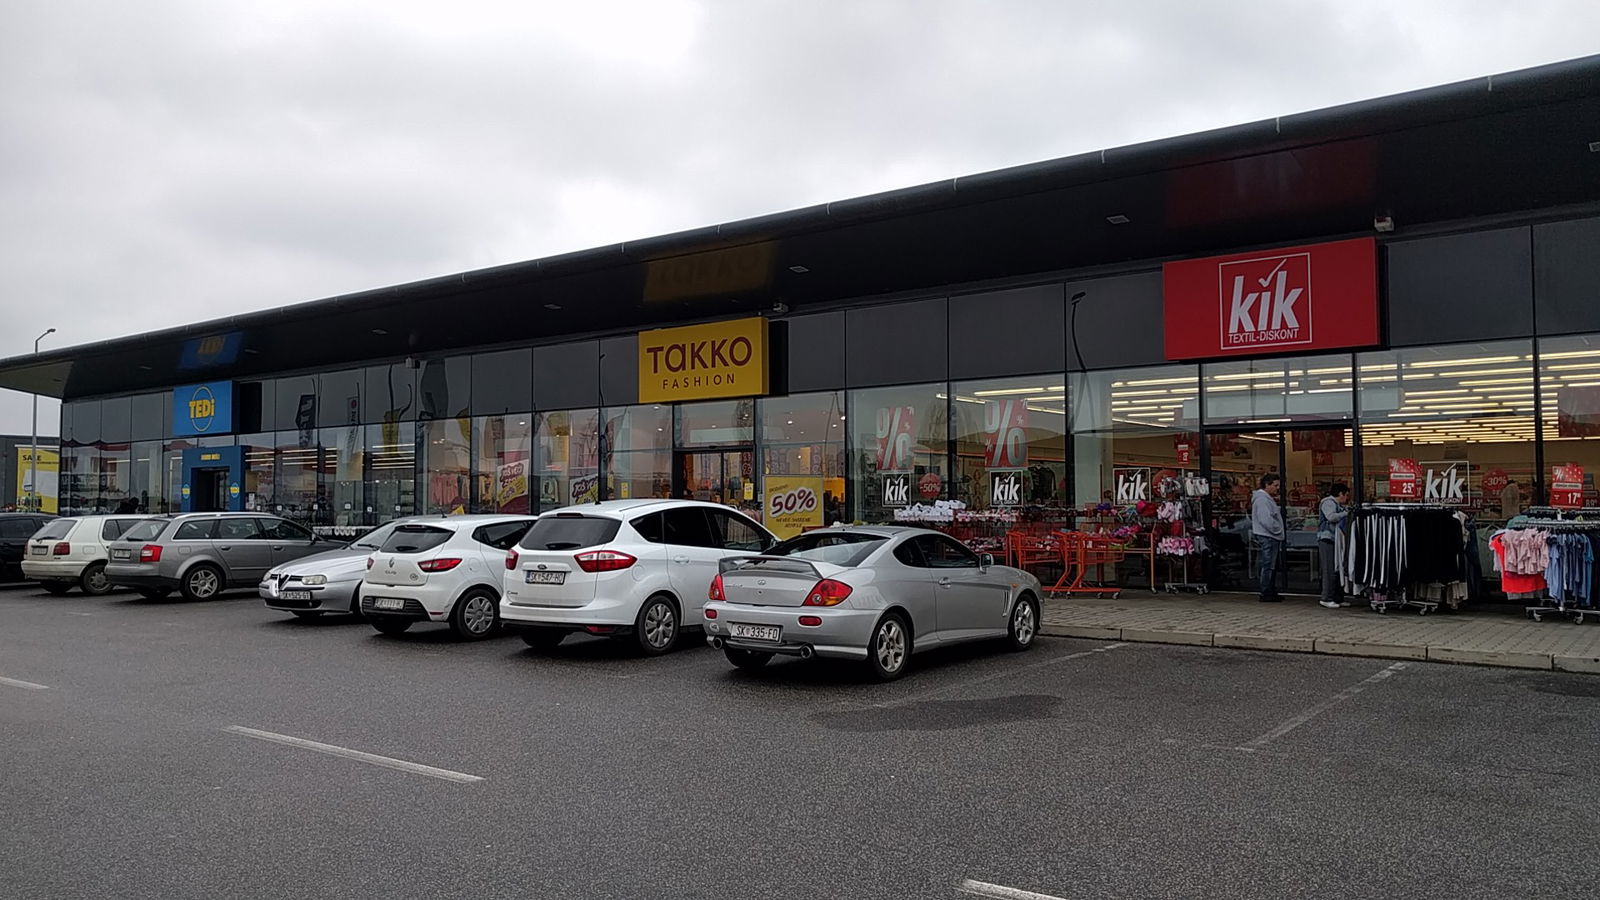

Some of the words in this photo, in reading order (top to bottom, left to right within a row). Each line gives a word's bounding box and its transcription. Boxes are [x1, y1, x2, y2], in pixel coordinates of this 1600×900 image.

[1228, 328, 1300, 344] TEXTIL-DISKONT
[662, 373, 735, 390] FASHION
[885, 473, 909, 501] kik
[993, 471, 1020, 501] kik
[1117, 469, 1148, 500] kik
[1424, 463, 1465, 500] kik
[771, 488, 816, 516] 50%
[736, 625, 746, 636] SK
